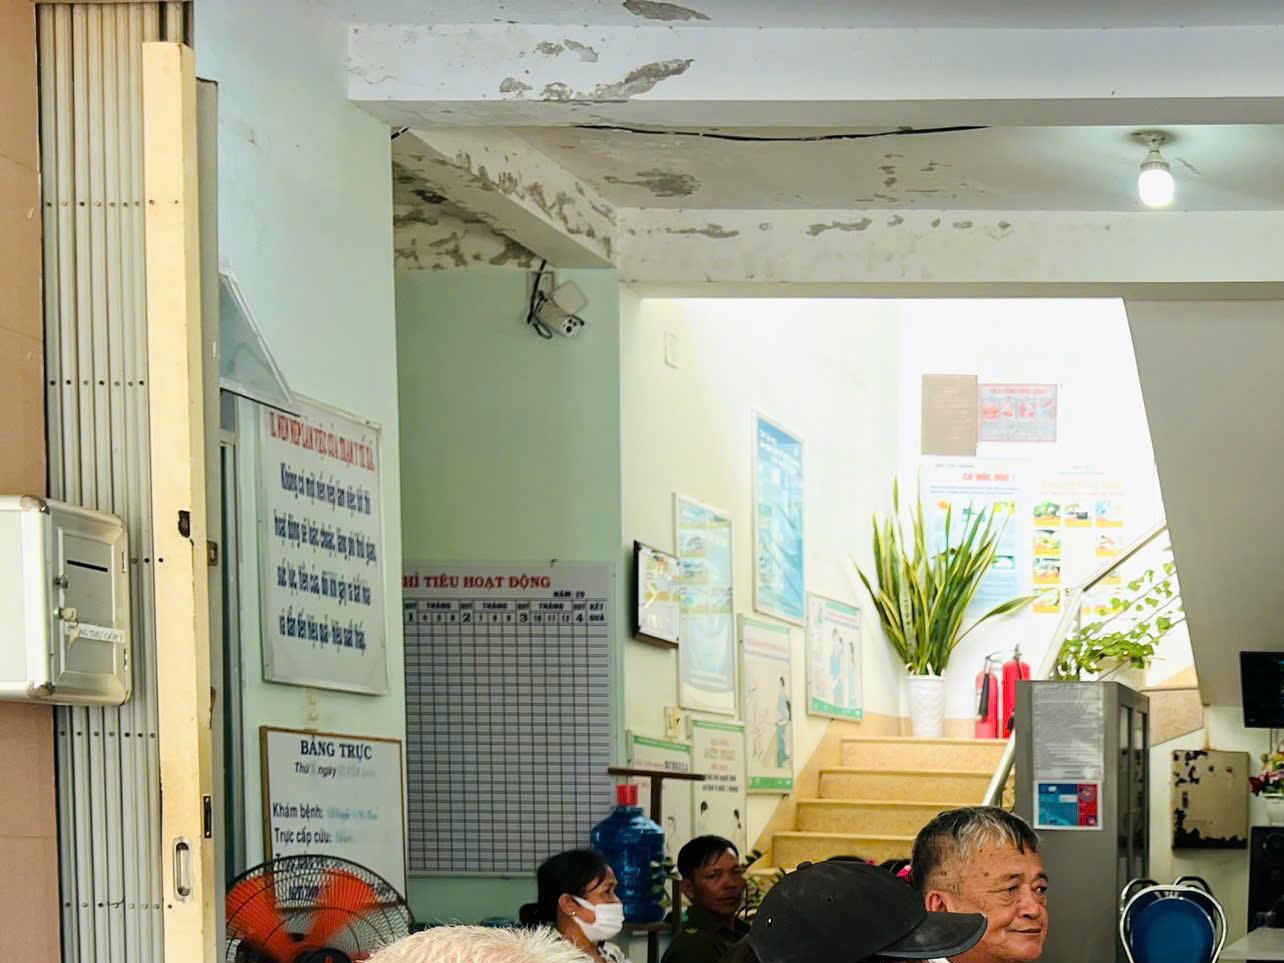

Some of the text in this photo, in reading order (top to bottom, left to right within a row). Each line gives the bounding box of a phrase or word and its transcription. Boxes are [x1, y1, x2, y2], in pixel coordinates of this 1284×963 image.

[424, 572, 458, 588] TIÊU
[463, 575, 505, 591] HOẠT
[509, 573, 551, 590] ĐỘNG
[301, 735, 373, 763] BẢNG TRỰC
[273, 802, 298, 818] Khám
